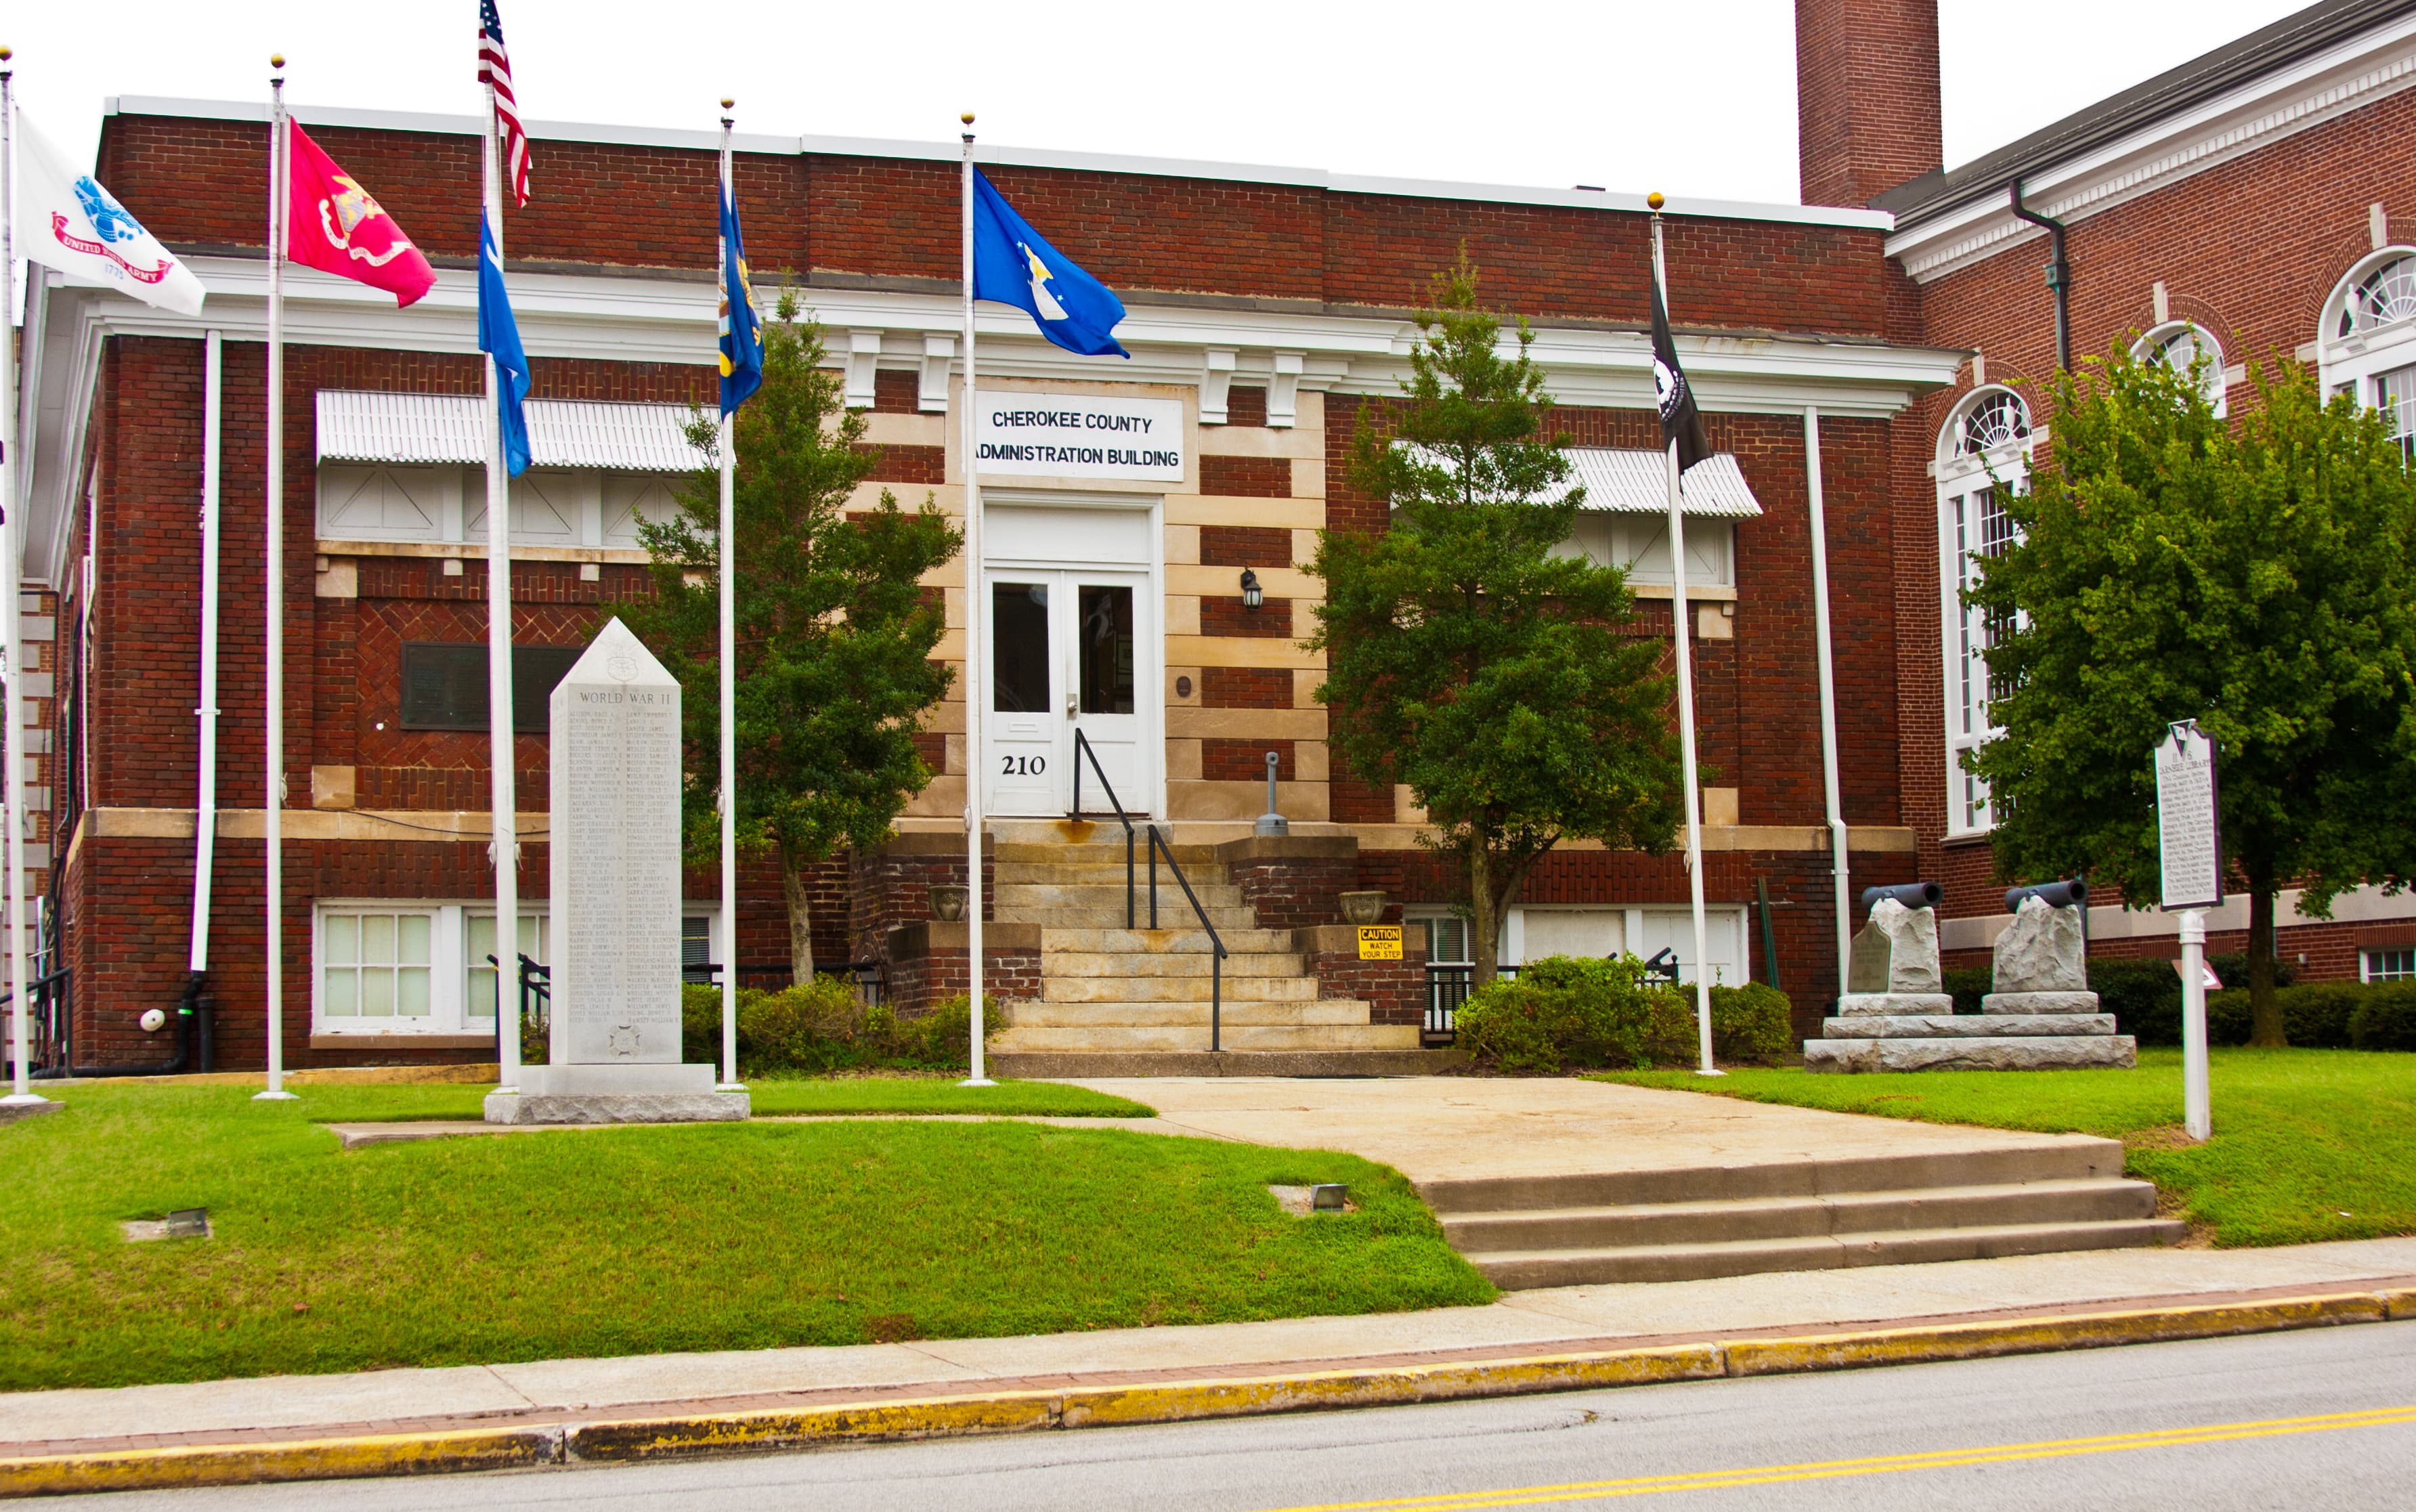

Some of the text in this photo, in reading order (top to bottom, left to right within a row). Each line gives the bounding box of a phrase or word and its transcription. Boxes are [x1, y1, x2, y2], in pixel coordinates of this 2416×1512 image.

[63, 236, 100, 254] UNITED
[127, 265, 158, 281] ARMY
[105, 263, 124, 280] 1775
[992, 411, 1152, 433] CHEROKEE COUNTY
[1108, 448, 1179, 467] BUILDING
[580, 692, 671, 705] WORLD WAR II
[1002, 756, 1046, 775] 210
[1362, 929, 1398, 940] CAUTION
